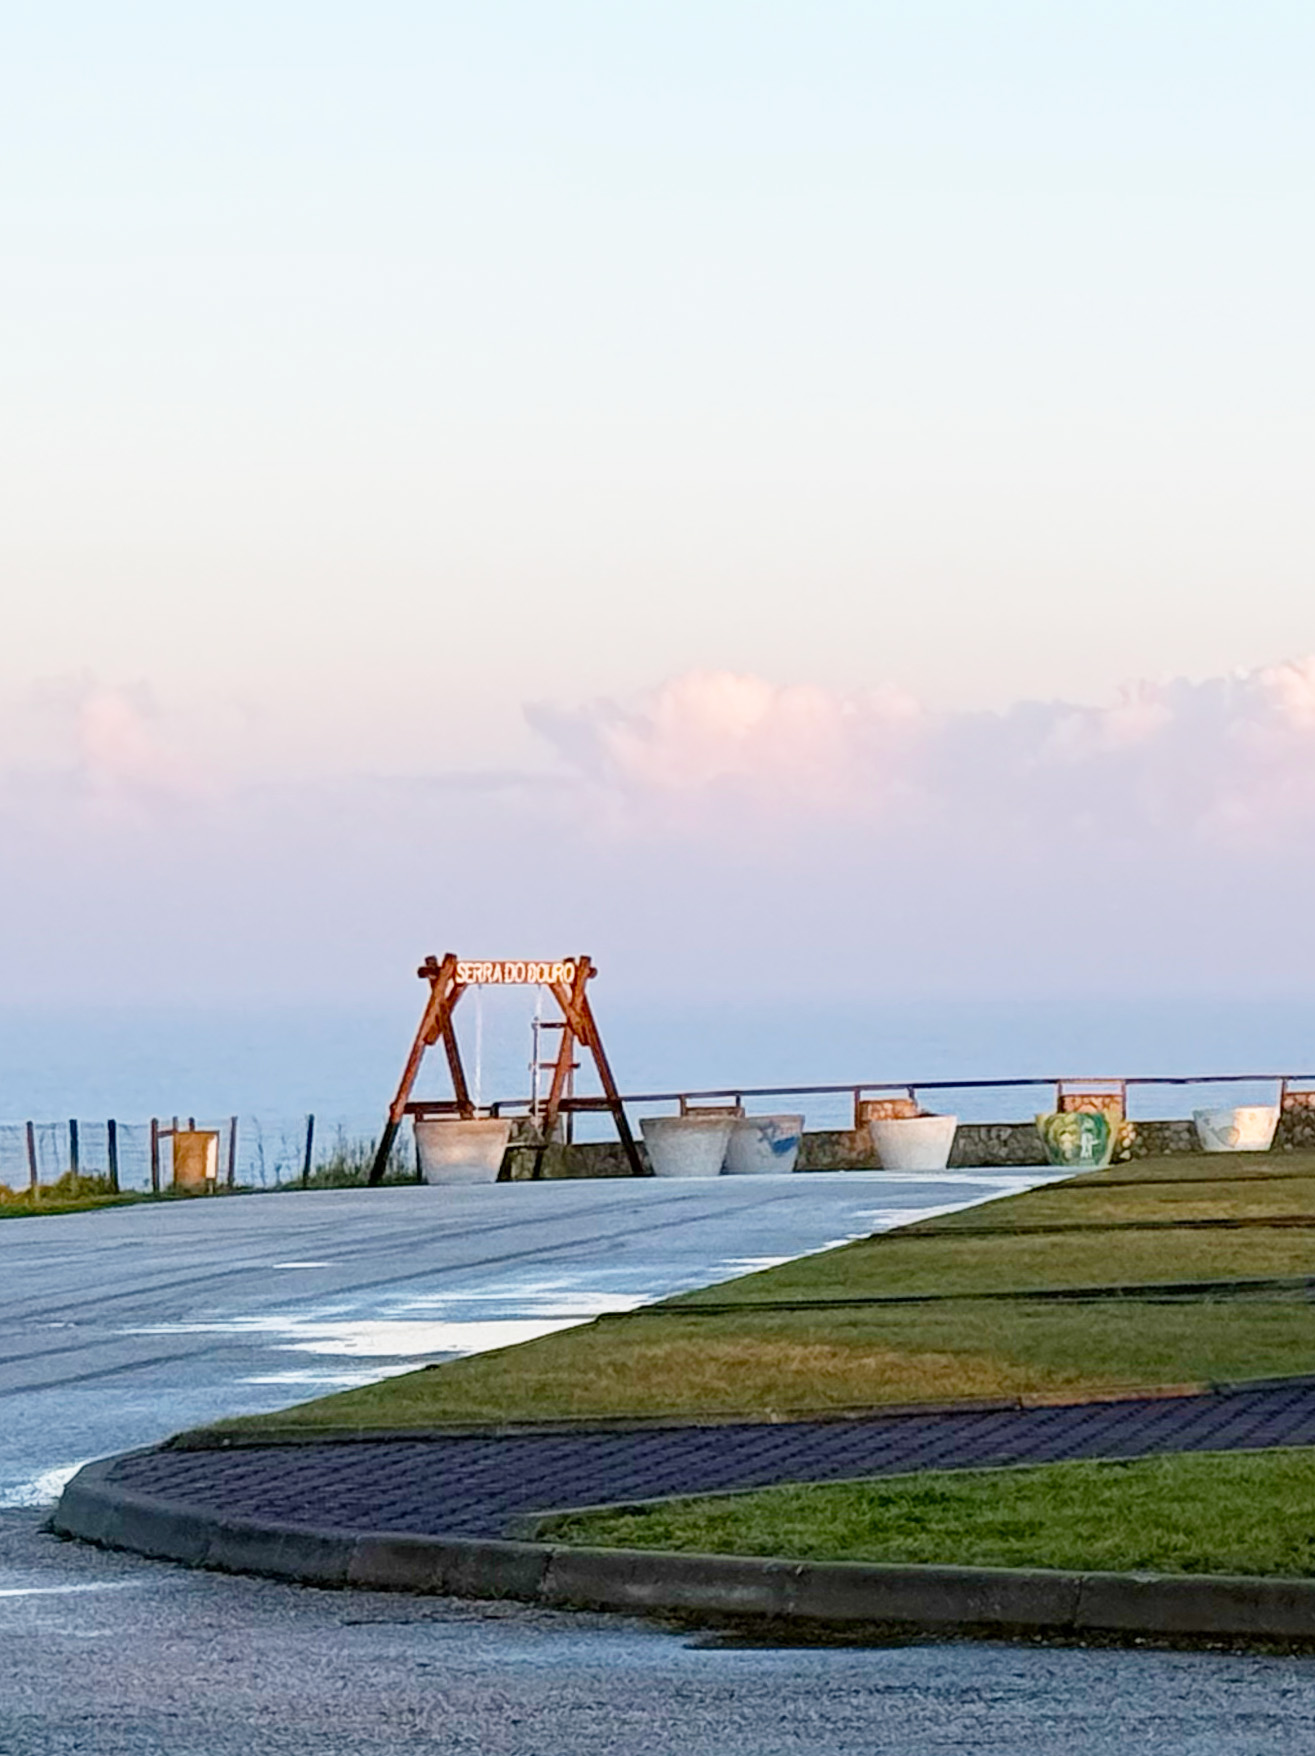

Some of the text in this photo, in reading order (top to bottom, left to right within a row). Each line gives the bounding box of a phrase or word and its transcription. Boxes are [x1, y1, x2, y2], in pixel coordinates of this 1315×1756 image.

[456, 962, 575, 984] SERRA DO DOURO
